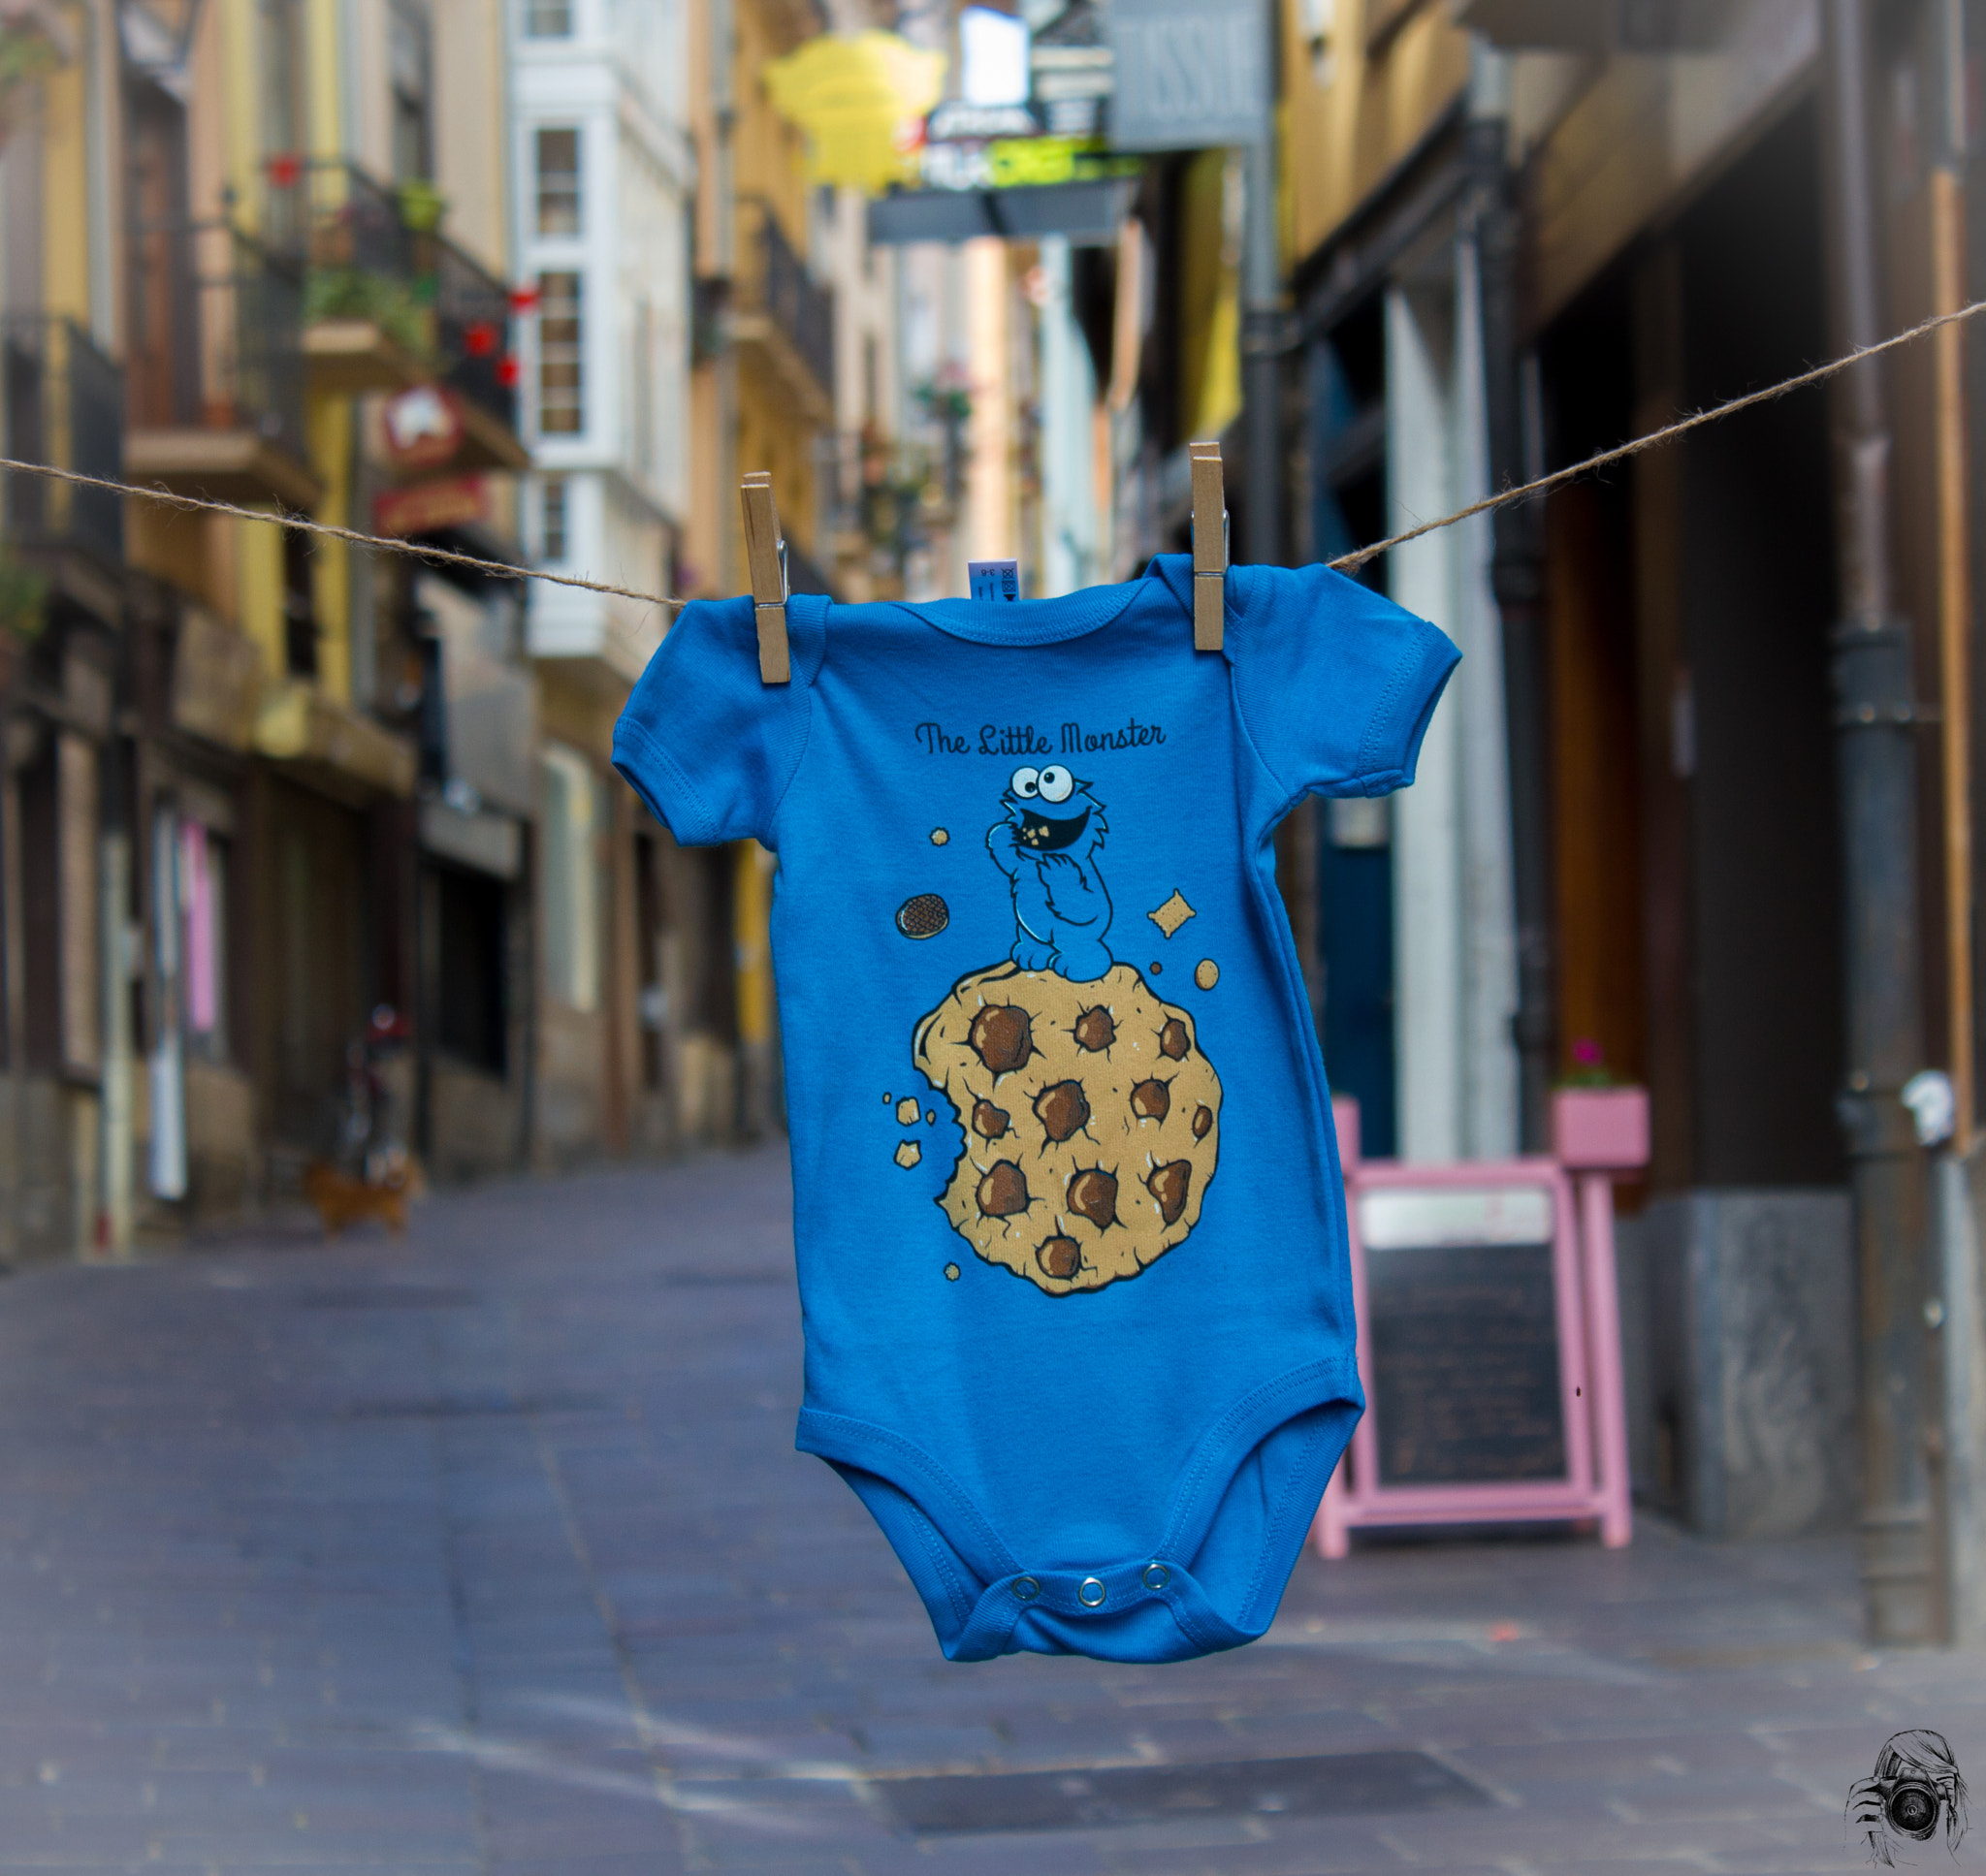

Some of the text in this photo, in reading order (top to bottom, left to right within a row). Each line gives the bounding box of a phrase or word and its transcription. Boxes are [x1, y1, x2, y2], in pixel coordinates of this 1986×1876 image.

[915, 717, 1167, 755] The Little Monster
